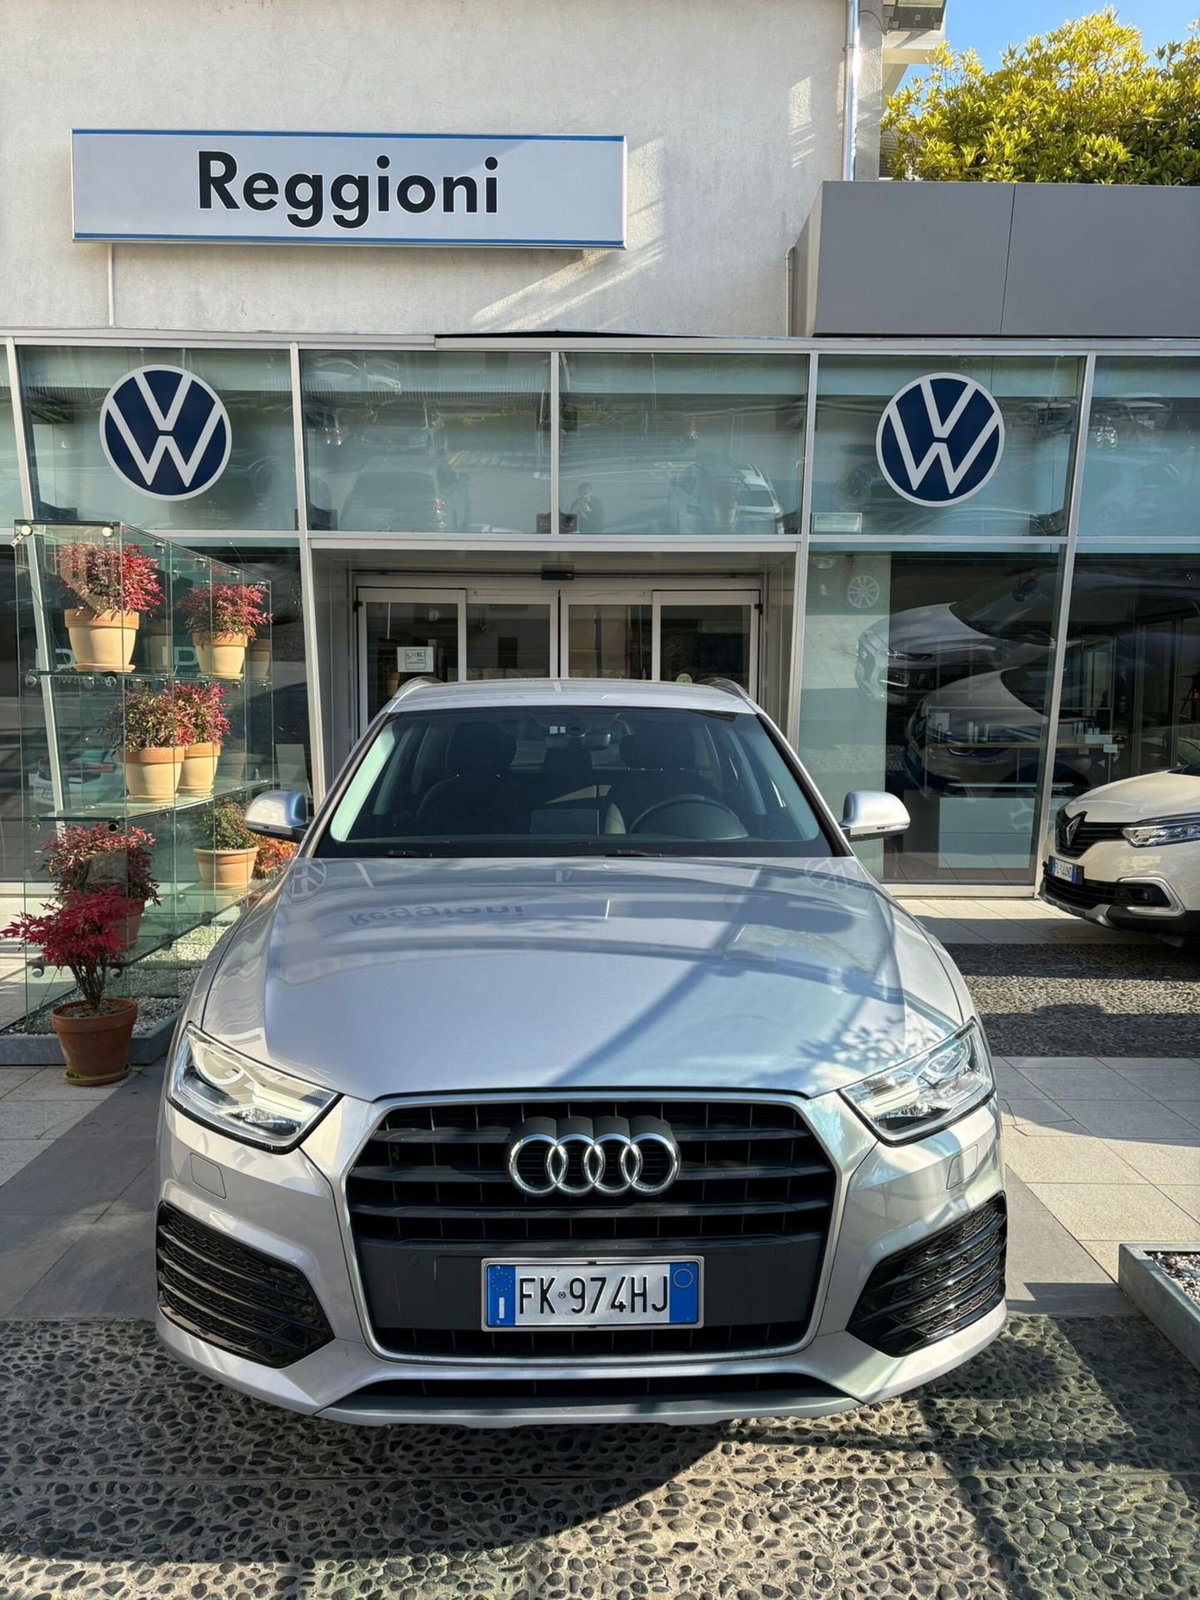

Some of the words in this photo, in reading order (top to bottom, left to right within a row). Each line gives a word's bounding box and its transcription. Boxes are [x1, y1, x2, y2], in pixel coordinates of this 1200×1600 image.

[198, 150, 499, 229] Reggioni
[103, 366, 228, 492] VW
[879, 376, 1002, 499] VW
[519, 1276, 556, 1315] FK
[569, 1276, 668, 1315] 974HJ
